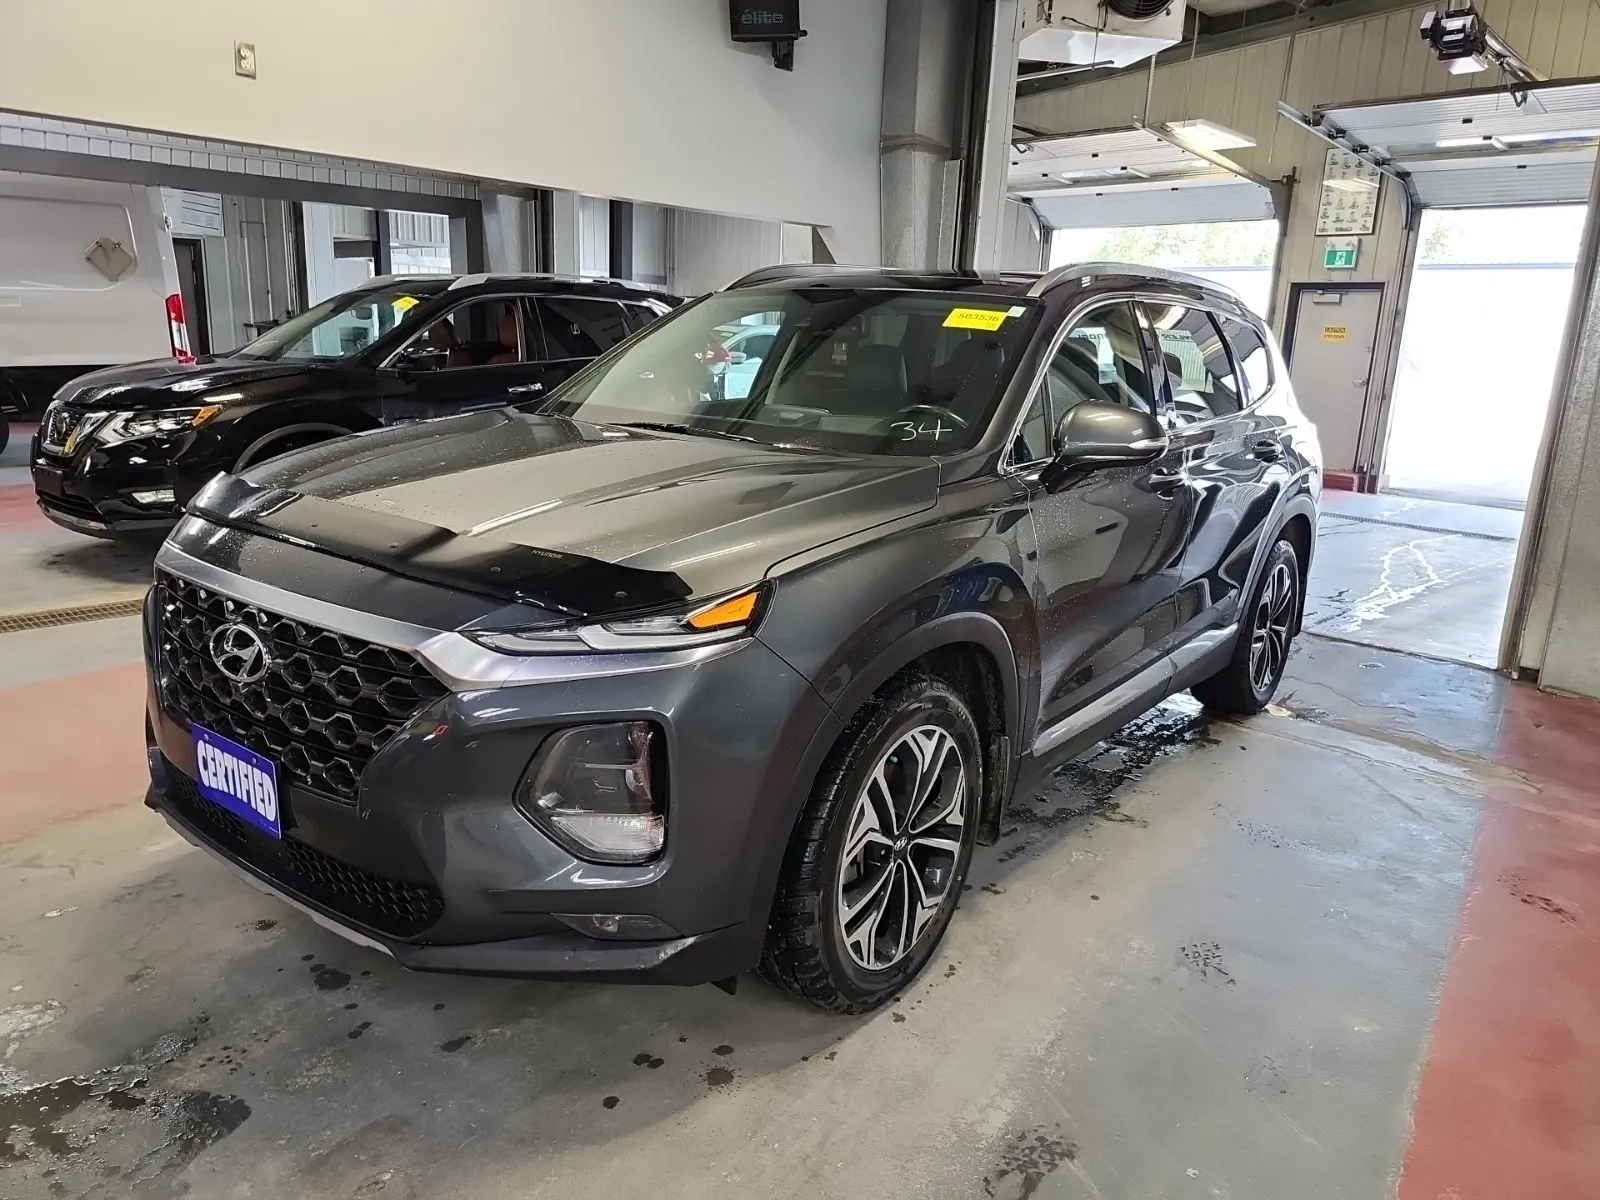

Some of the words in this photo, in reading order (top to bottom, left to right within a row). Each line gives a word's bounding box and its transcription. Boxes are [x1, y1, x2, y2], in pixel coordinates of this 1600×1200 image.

[742, 9, 784, 25] élite
[890, 418, 953, 441] 34
[532, 549, 564, 560] HYUNDAI
[197, 739, 277, 822] CERTIFIED
